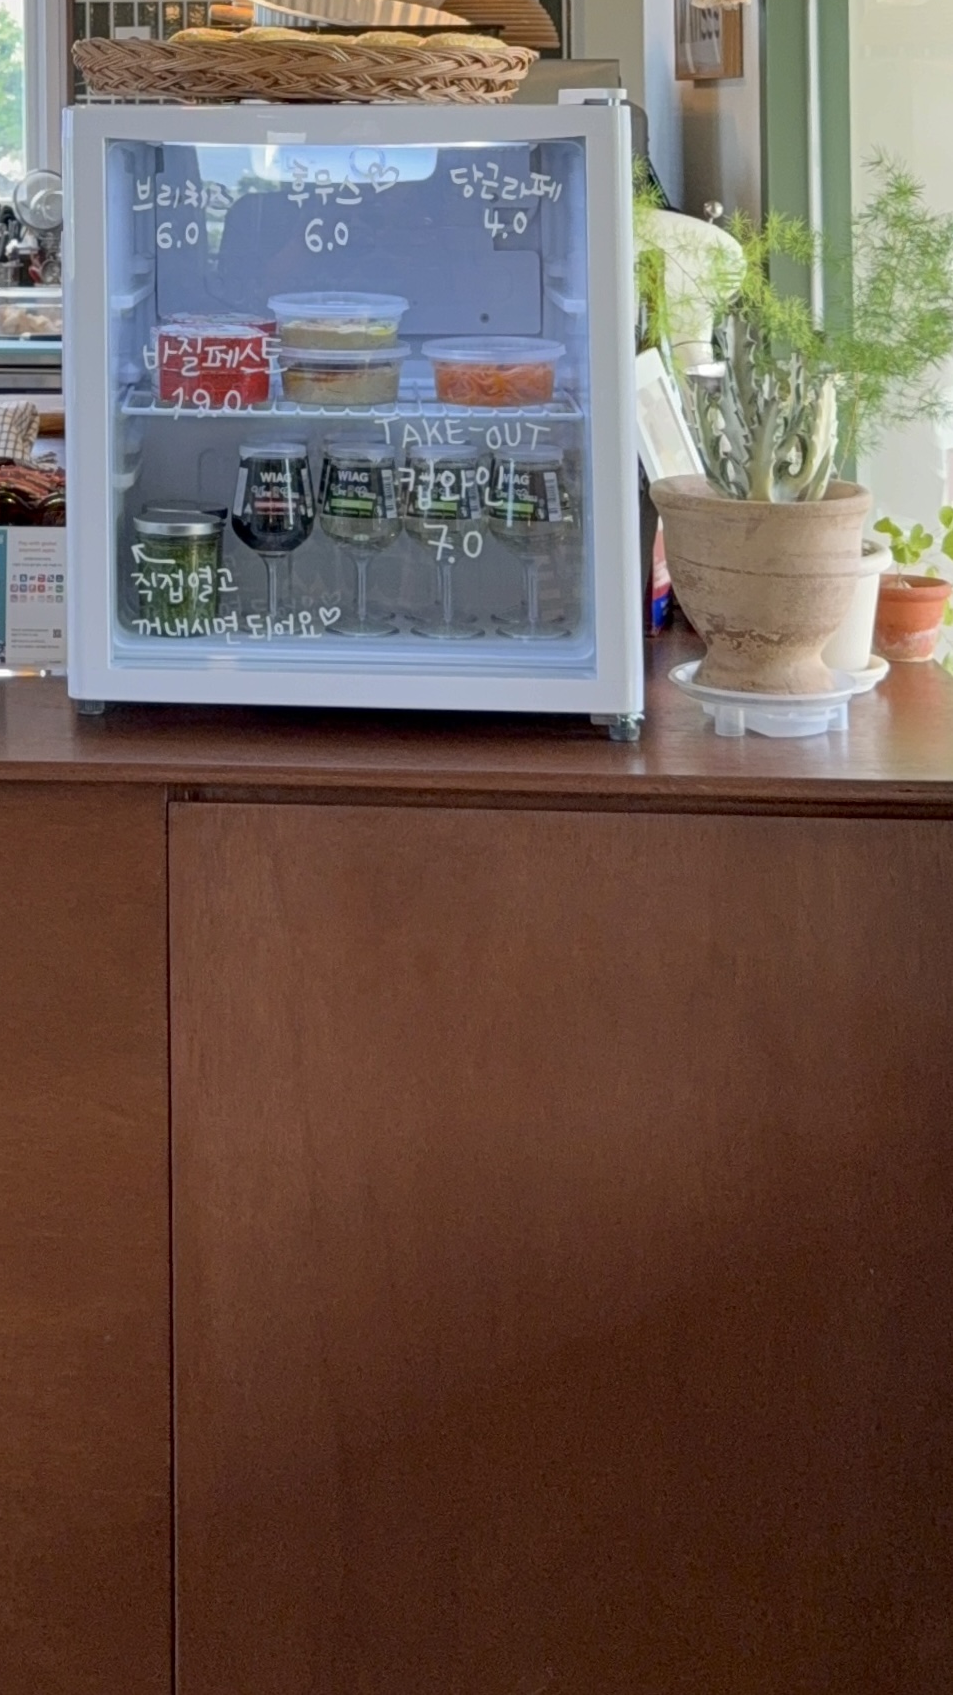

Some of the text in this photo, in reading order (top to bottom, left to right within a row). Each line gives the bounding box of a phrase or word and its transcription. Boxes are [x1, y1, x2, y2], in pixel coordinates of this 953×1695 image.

[132, 176, 229, 215] 브리치즈
[288, 159, 362, 208] 후무스
[450, 162, 562, 202] 당근라페
[156, 221, 198, 249] 6.0
[305, 218, 348, 252] 6.0
[484, 208, 527, 239] 4.0
[143, 337, 288, 376] 바질페스토
[172, 387, 241, 420] 19.0
[374, 417, 551, 450] TAKE-OUT
[398, 459, 504, 510] 컵와인
[424, 523, 483, 563] 7.0
[132, 611, 322, 644] 꺼내시면 되어요
